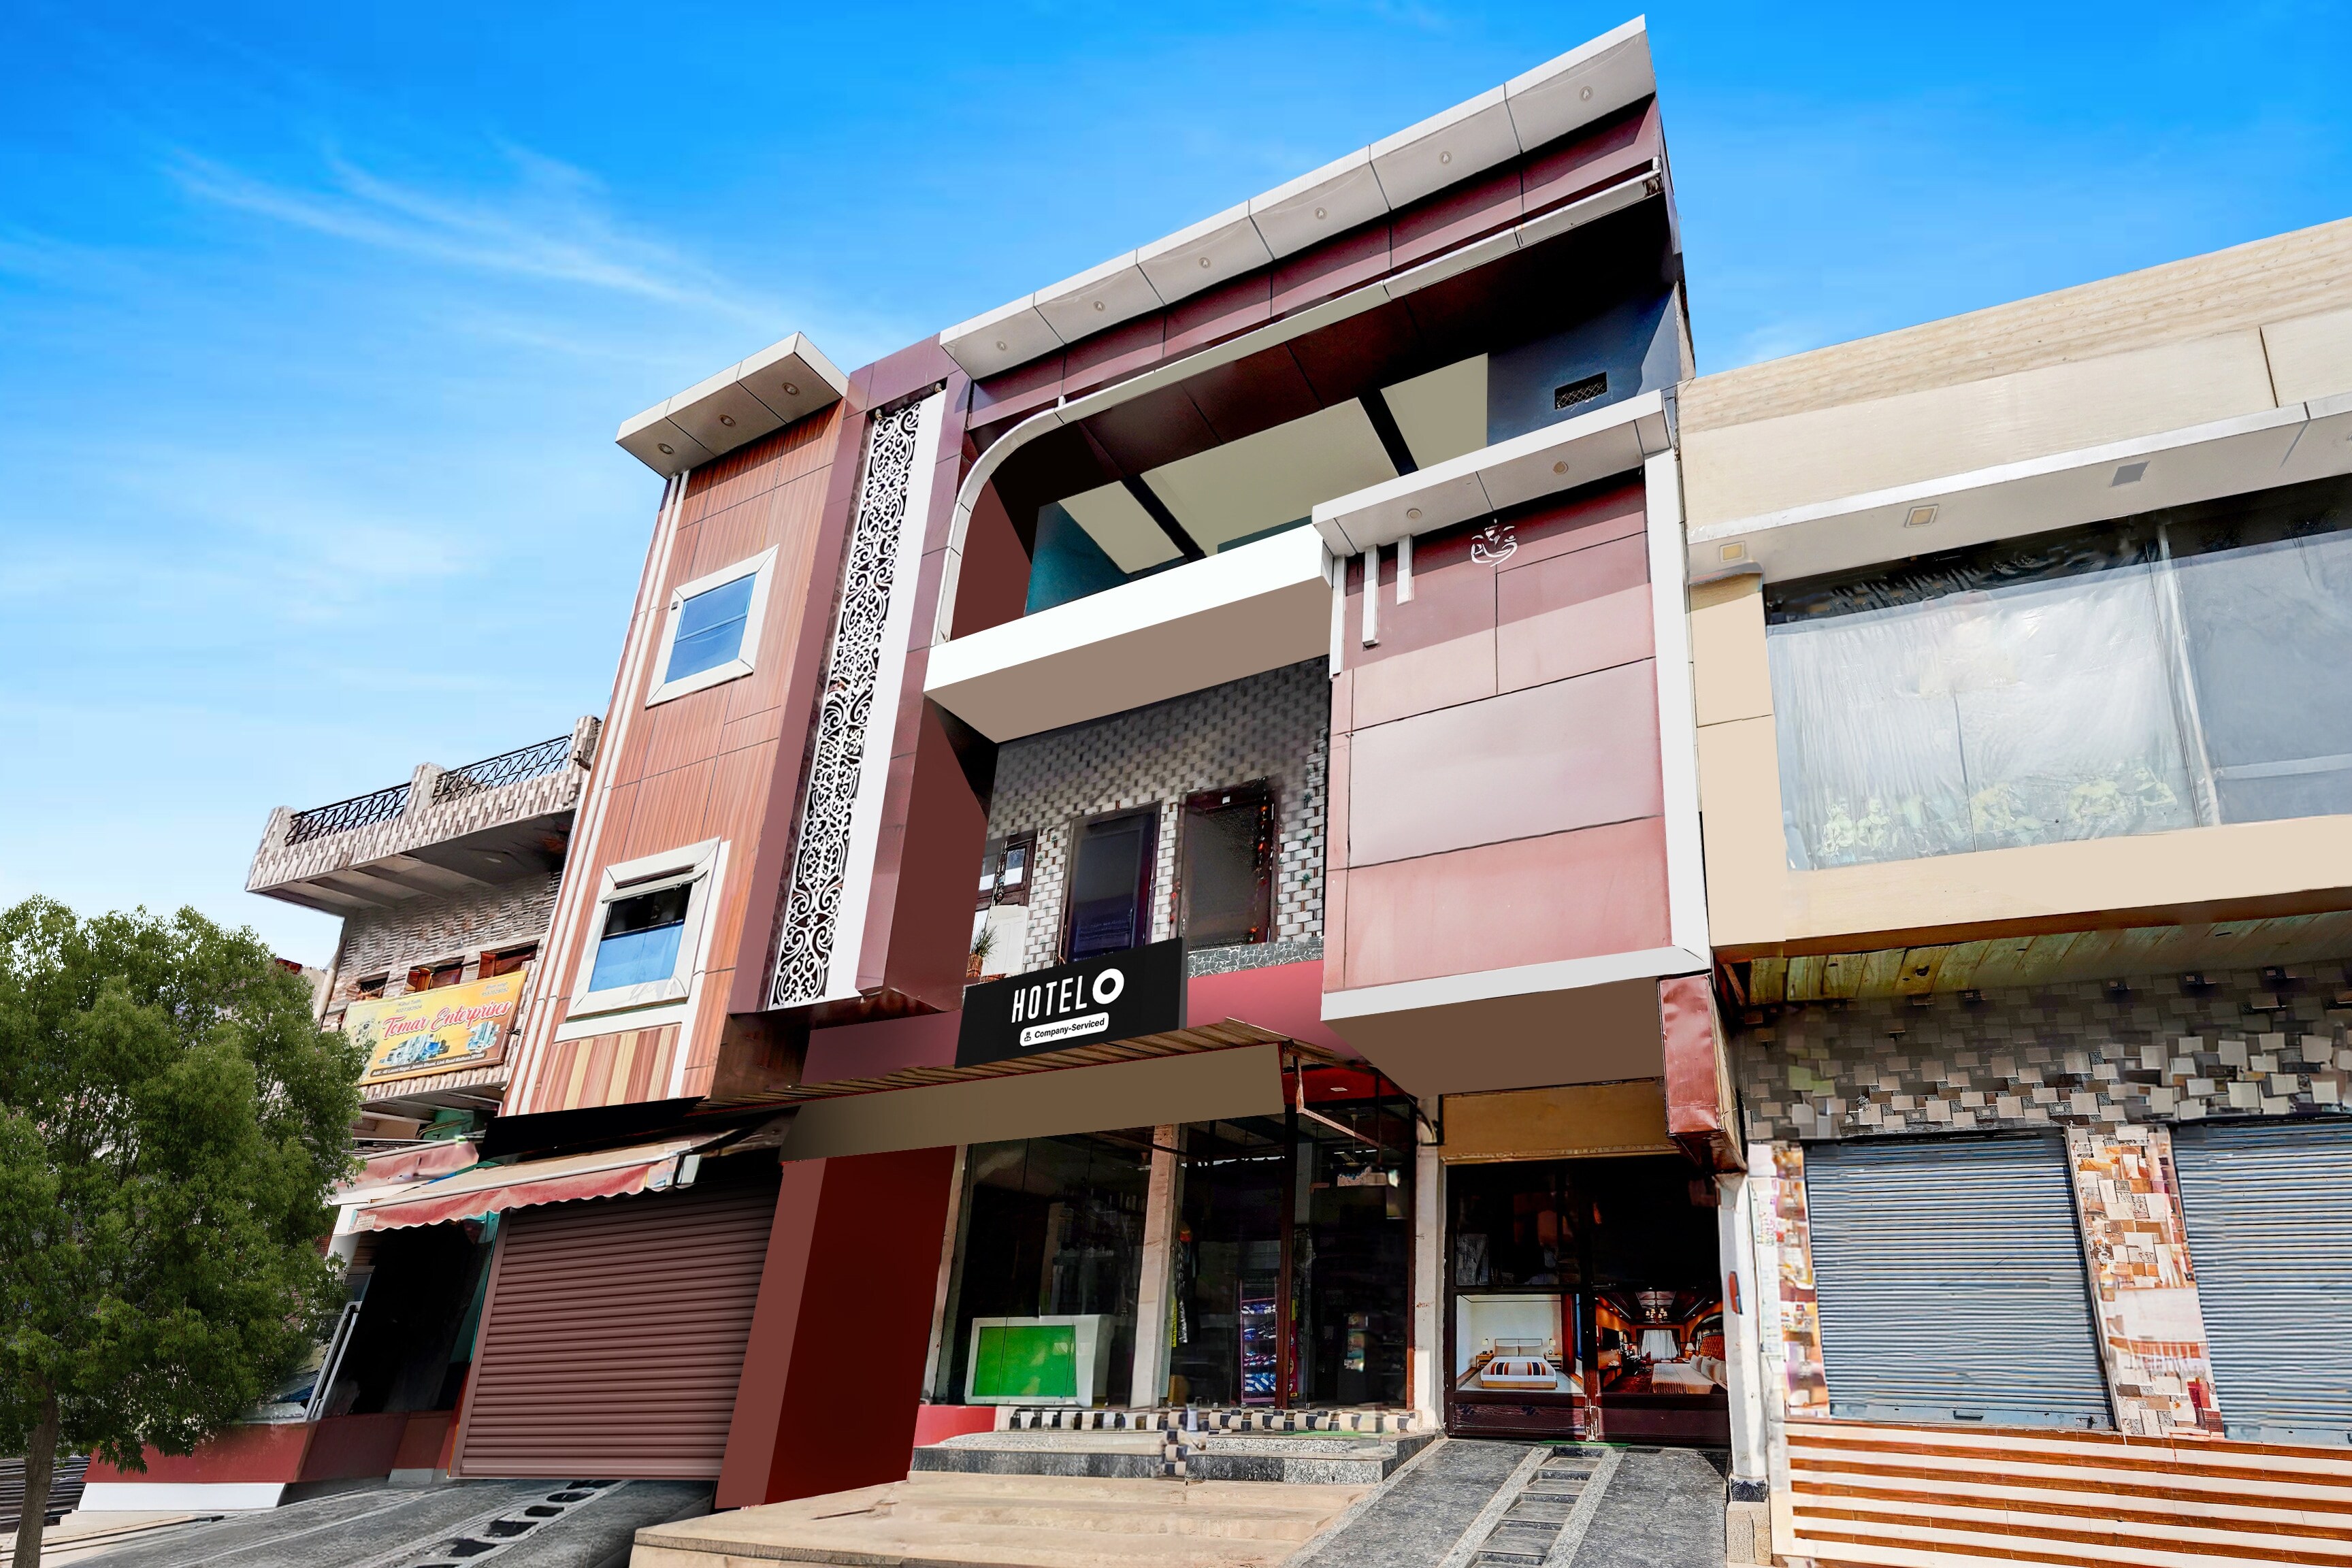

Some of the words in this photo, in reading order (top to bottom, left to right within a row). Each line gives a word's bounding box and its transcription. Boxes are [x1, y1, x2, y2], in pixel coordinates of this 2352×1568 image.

[1011, 975, 1088, 1024] HOTEL
[1092, 968, 1124, 1004] O
[382, 1015, 428, 1040] Tomar
[430, 1000, 512, 1032] Enterprises
[1034, 1018, 1105, 1039] Company-Serviced
